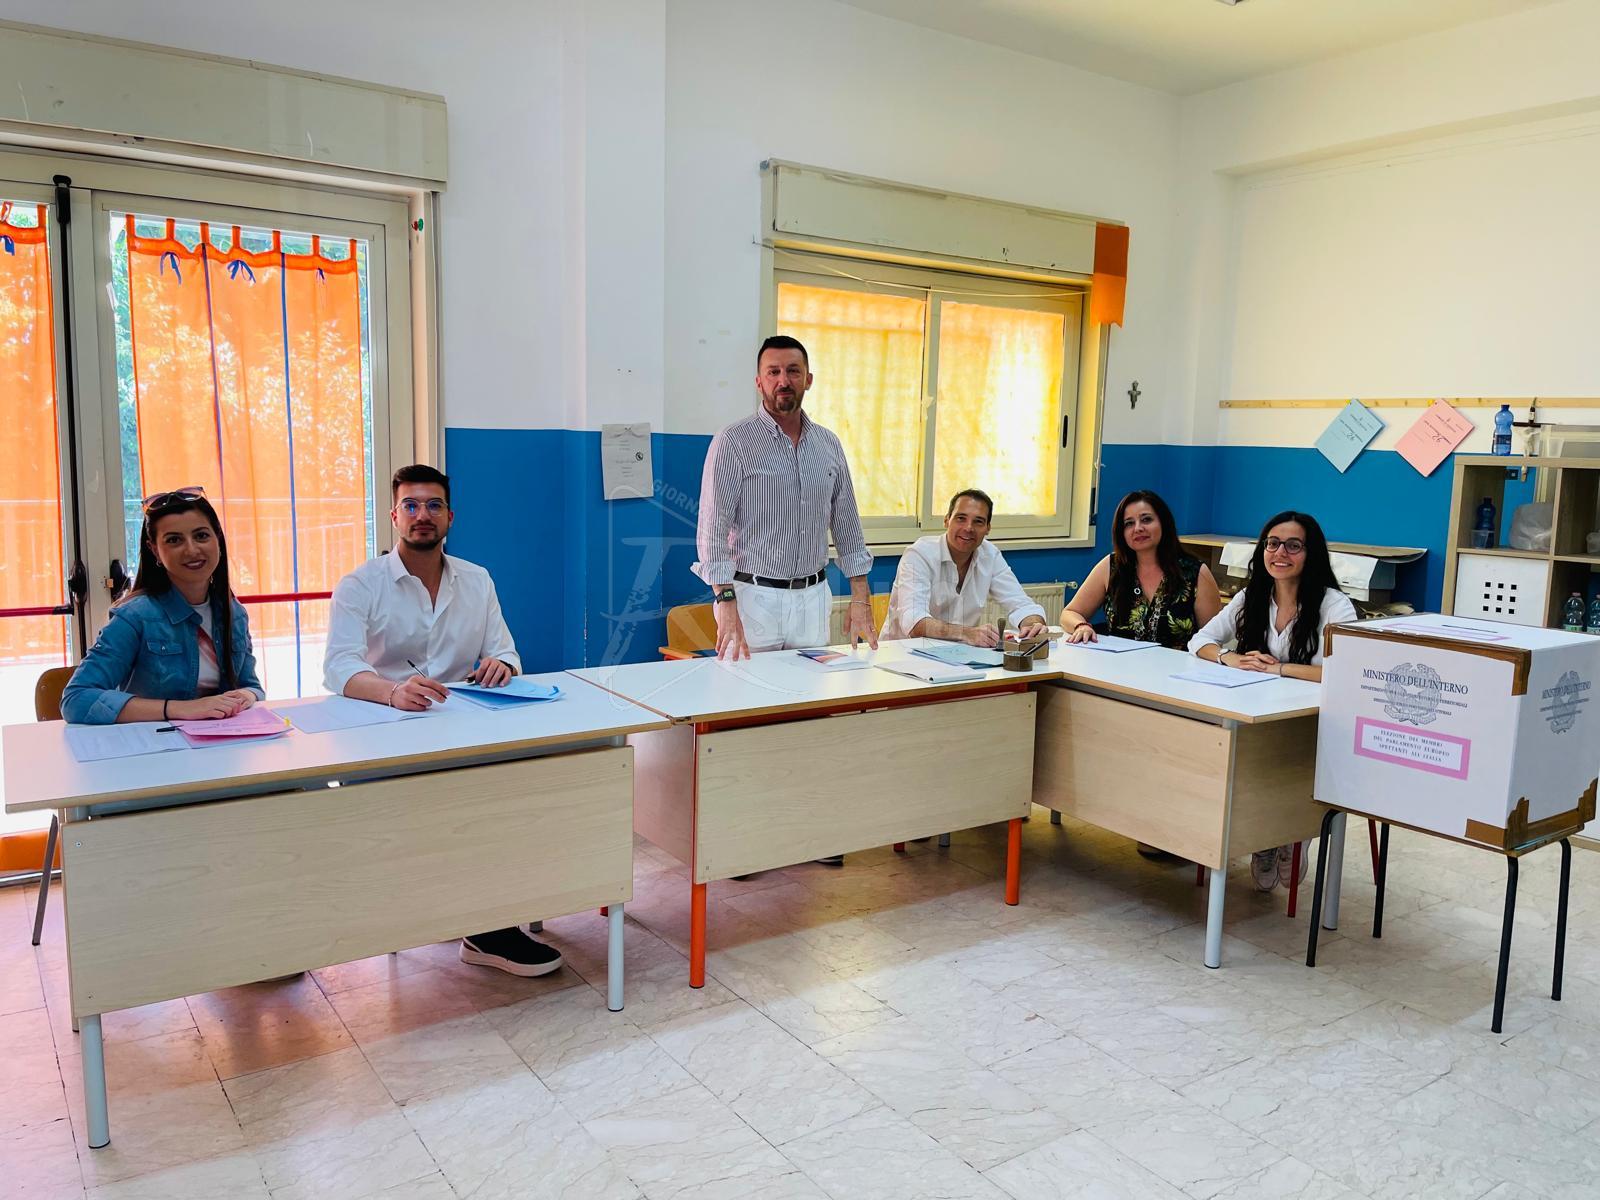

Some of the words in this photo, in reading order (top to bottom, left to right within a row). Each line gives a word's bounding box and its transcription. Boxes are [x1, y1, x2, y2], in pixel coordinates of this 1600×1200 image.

[1362, 669, 1406, 685] MINISTERO
[1407, 676, 1468, 695] DELL'INTERNO
[1386, 738, 1421, 750] PARLAMENTO
